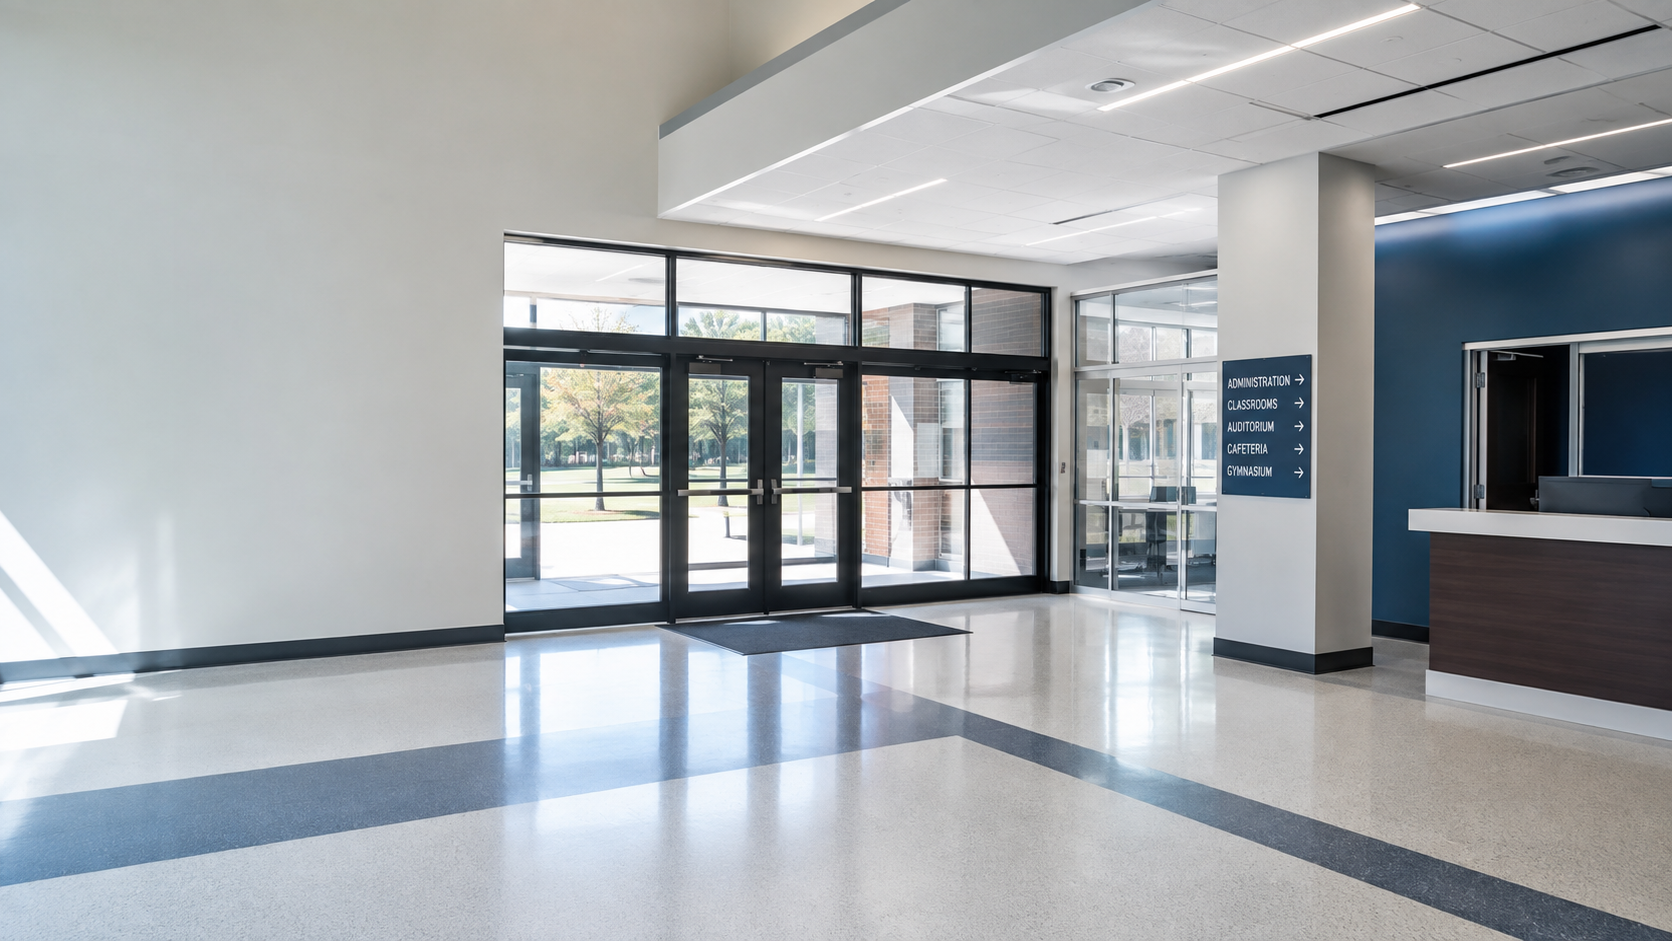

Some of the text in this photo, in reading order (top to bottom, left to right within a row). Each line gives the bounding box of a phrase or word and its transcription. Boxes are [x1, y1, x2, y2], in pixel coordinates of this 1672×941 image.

[1227, 374, 1291, 389] ADMINISTRATION
[1227, 398, 1278, 411] CLASSROOMS
[1227, 420, 1275, 433] AUDITORIUM
[1227, 443, 1269, 455] CAFETERIA
[1227, 465, 1273, 477] GYMNASIUM
